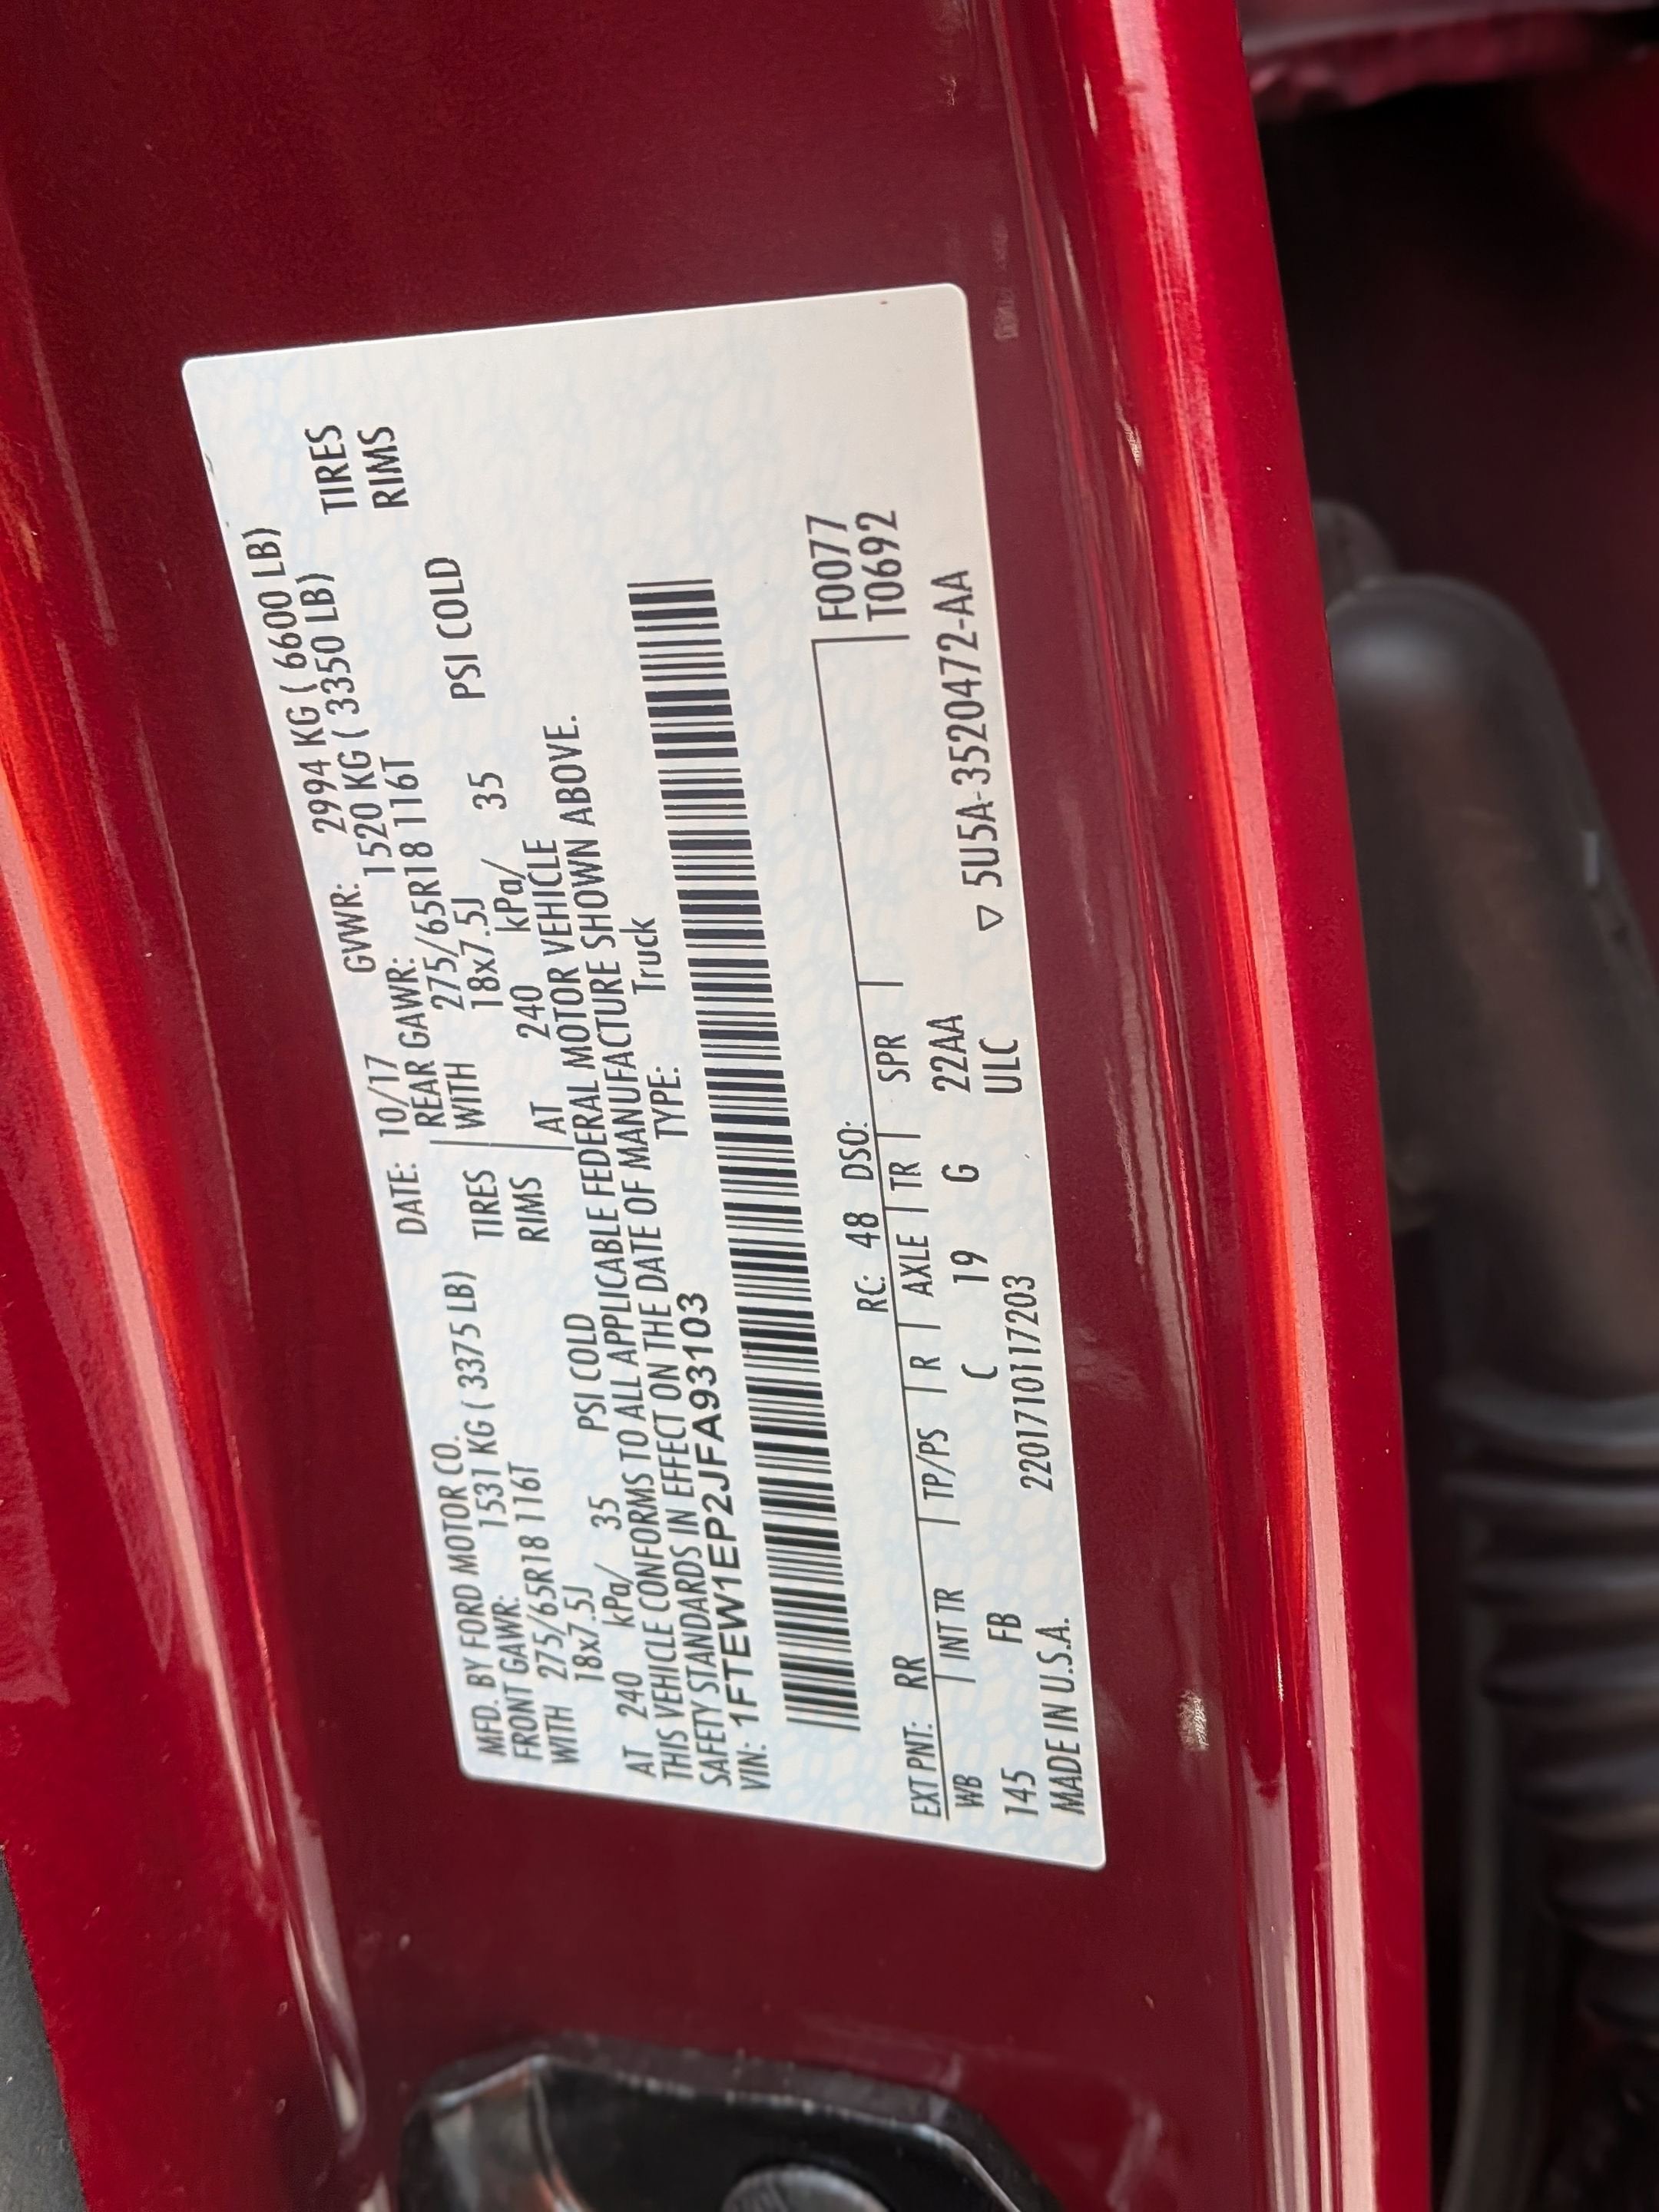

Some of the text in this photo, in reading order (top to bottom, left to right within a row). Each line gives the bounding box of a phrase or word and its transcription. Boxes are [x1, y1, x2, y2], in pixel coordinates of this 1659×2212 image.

[303, 423, 358, 515] TIRES
[356, 425, 410, 508] RIMS
[240, 527, 286, 578] LB)
[805, 513, 859, 621] F0077
[854, 509, 907, 622] T0692
[257, 589, 308, 669] 6600
[294, 572, 339, 622] LB)
[310, 634, 360, 715] 3350
[285, 705, 327, 746] KG
[929, 568, 1003, 887] 5U5A-3520472-AA
[297, 758, 348, 833] 2994
[336, 749, 378, 790] KG
[348, 801, 396, 876] 1520
[424, 556, 568, 1134] AT 240 kPa/ 35 PSI COLD
[329, 882, 376, 973] GVWR:
[379, 755, 487, 1130] WITH 275/65R18 116T
[449, 897, 504, 1009] 18x7.5J
[384, 957, 431, 1048] GAWR:
[618, 916, 689, 1140] TYPE: Truck
[873, 1033, 911, 1082] SPR
[925, 1013, 972, 1093] 22AA
[978, 1037, 1023, 1094] ULC
[403, 1059, 447, 1127] REAR
[363, 1053, 428, 1235] DATE: 10/17
[887, 1161, 923, 1191] TR
[940, 1163, 980, 1183] G
[462, 1169, 505, 1240] TIRES
[508, 1176, 551, 1242] RIMS
[836, 1120, 889, 1313] RC: 48 DSO:
[542, 714, 733, 1786] SAFETY STANDARDS IN EFFECT ON THE DATE OF MANUFACTURE SHOWN ABOVE.
[895, 1233, 934, 1297] AXLE
[949, 1249, 990, 1283] 19
[441, 1270, 478, 1313] LB)
[522, 838, 694, 1780] THIS VEHICLE CONFORMS TO ALL APPLICABLE FEDERAL MOTOR VEHICLE
[449, 1321, 488, 1389] 3375
[909, 1355, 942, 1370] R
[960, 1362, 998, 1379] C
[1001, 1274, 1054, 1492] 2201710117203
[462, 1419, 498, 1455] KG
[915, 1426, 956, 1500] TP/PS
[470, 1468, 508, 1528] 1531
[563, 1313, 657, 1777] AT 240 kPa/ 35 PSI COLD
[675, 1292, 771, 1790] VIN: 1FTEW1EP2JFA93103
[430, 1435, 506, 1757] MFD. BY FORD MOTOR CO.
[490, 1594, 530, 1674] GAWR:
[507, 1460, 579, 1764] WITH 275/65R18 116T
[561, 1584, 605, 1681] 18x7.5J
[932, 1587, 970, 1661] INT TR
[985, 1611, 1023, 1644] FB
[502, 1681, 542, 1760] FRONT
[891, 1654, 942, 1818] EXT PNT: RR
[1034, 1617, 1086, 1815] MADE IN U.S.A.
[952, 1773, 985, 1807] WB
[1000, 1766, 1039, 1816] 145
